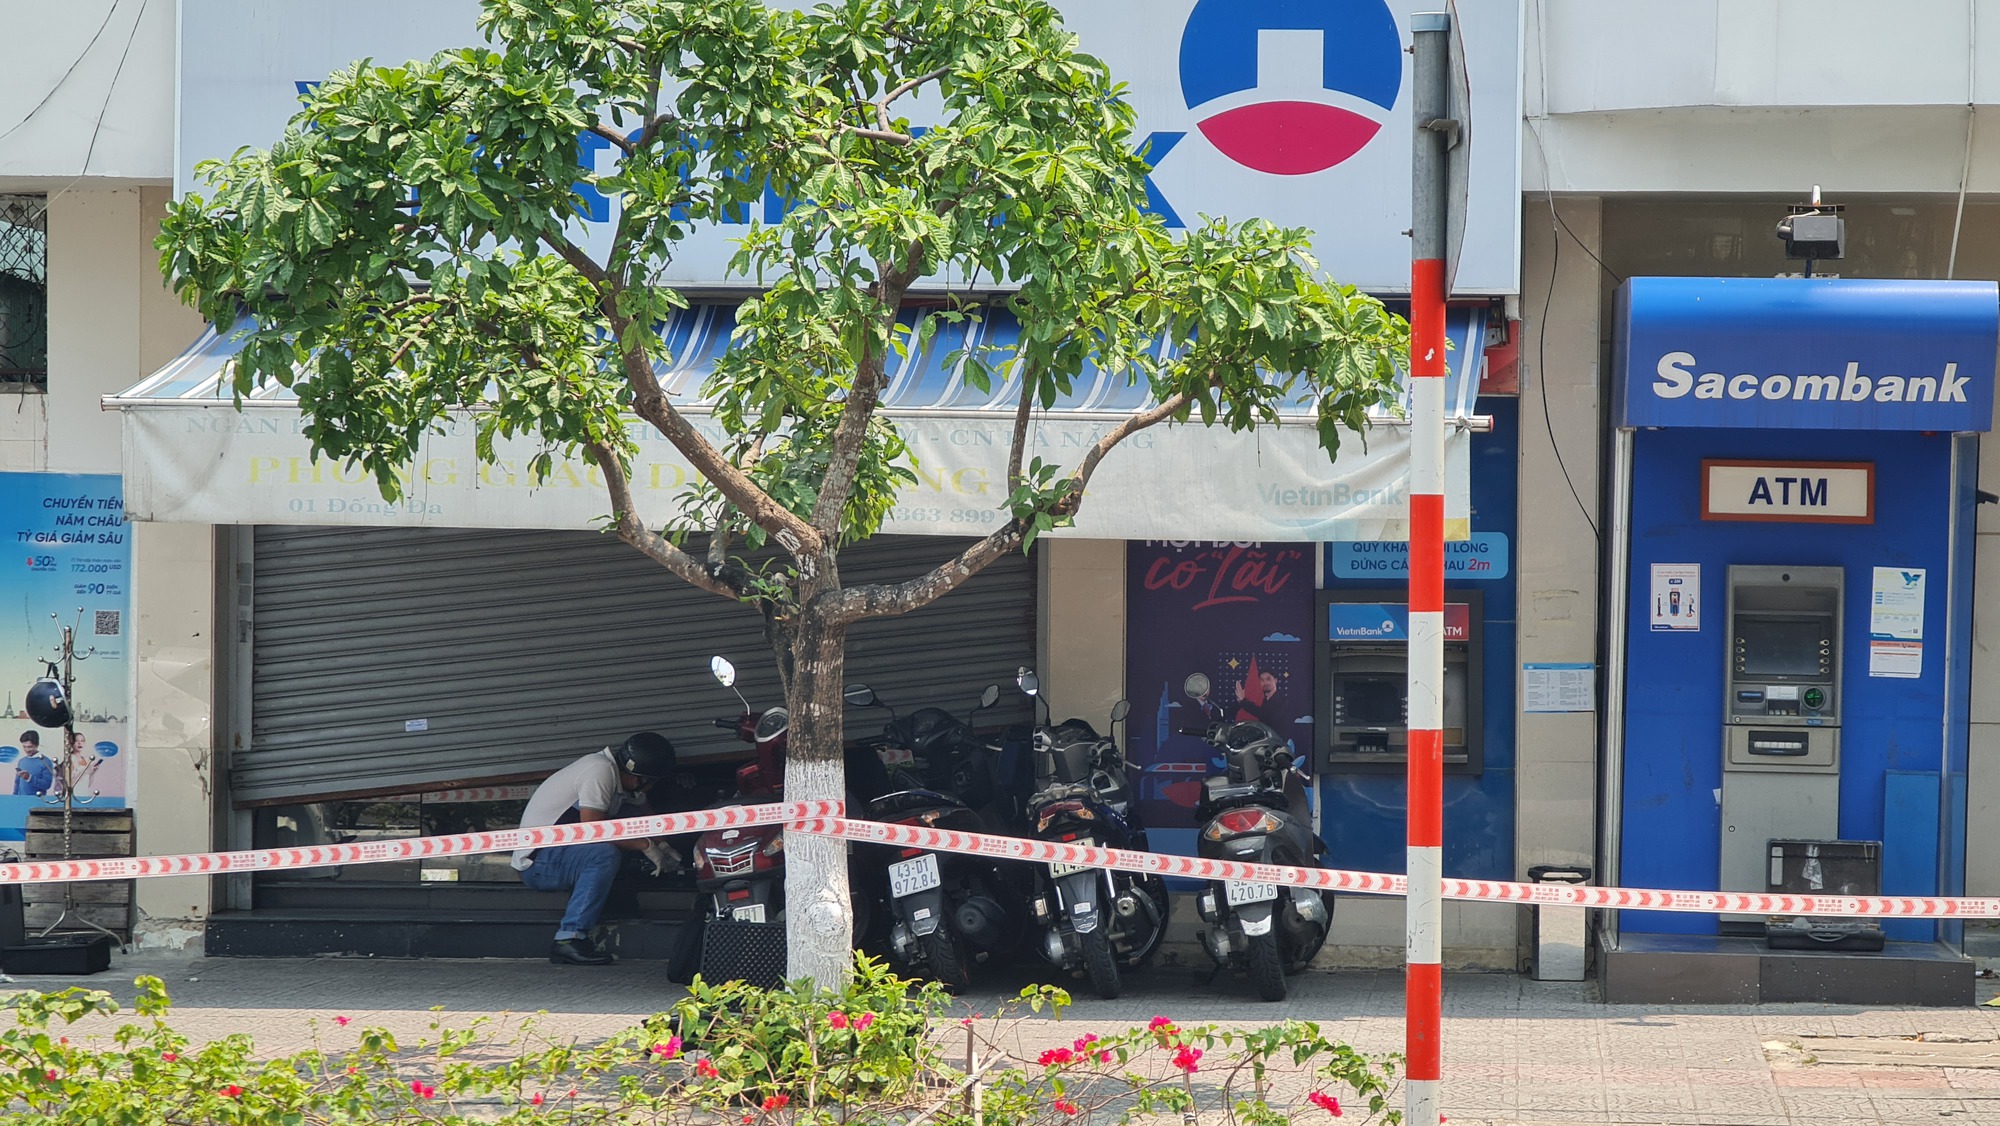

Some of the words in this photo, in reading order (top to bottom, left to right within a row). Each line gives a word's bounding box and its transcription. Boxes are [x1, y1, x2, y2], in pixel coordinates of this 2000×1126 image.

[1652, 351, 1972, 402] Sacombank
[950, 429, 994, 446] CN
[1748, 476, 1828, 507] ATM
[289, 498, 315, 513] 01
[55, 513, 85, 526] NĂM
[35, 530, 57, 543] GIÁ
[1351, 557, 1388, 571] ĐỨNG
[1468, 558, 1491, 571] 2m
[87, 583, 105, 595] 90
[1336, 627, 1383, 636] VietinBank
[897, 858, 929, 879] 43-D1
[894, 871, 937, 895] 972.84
[1231, 884, 1274, 903] 420.76
